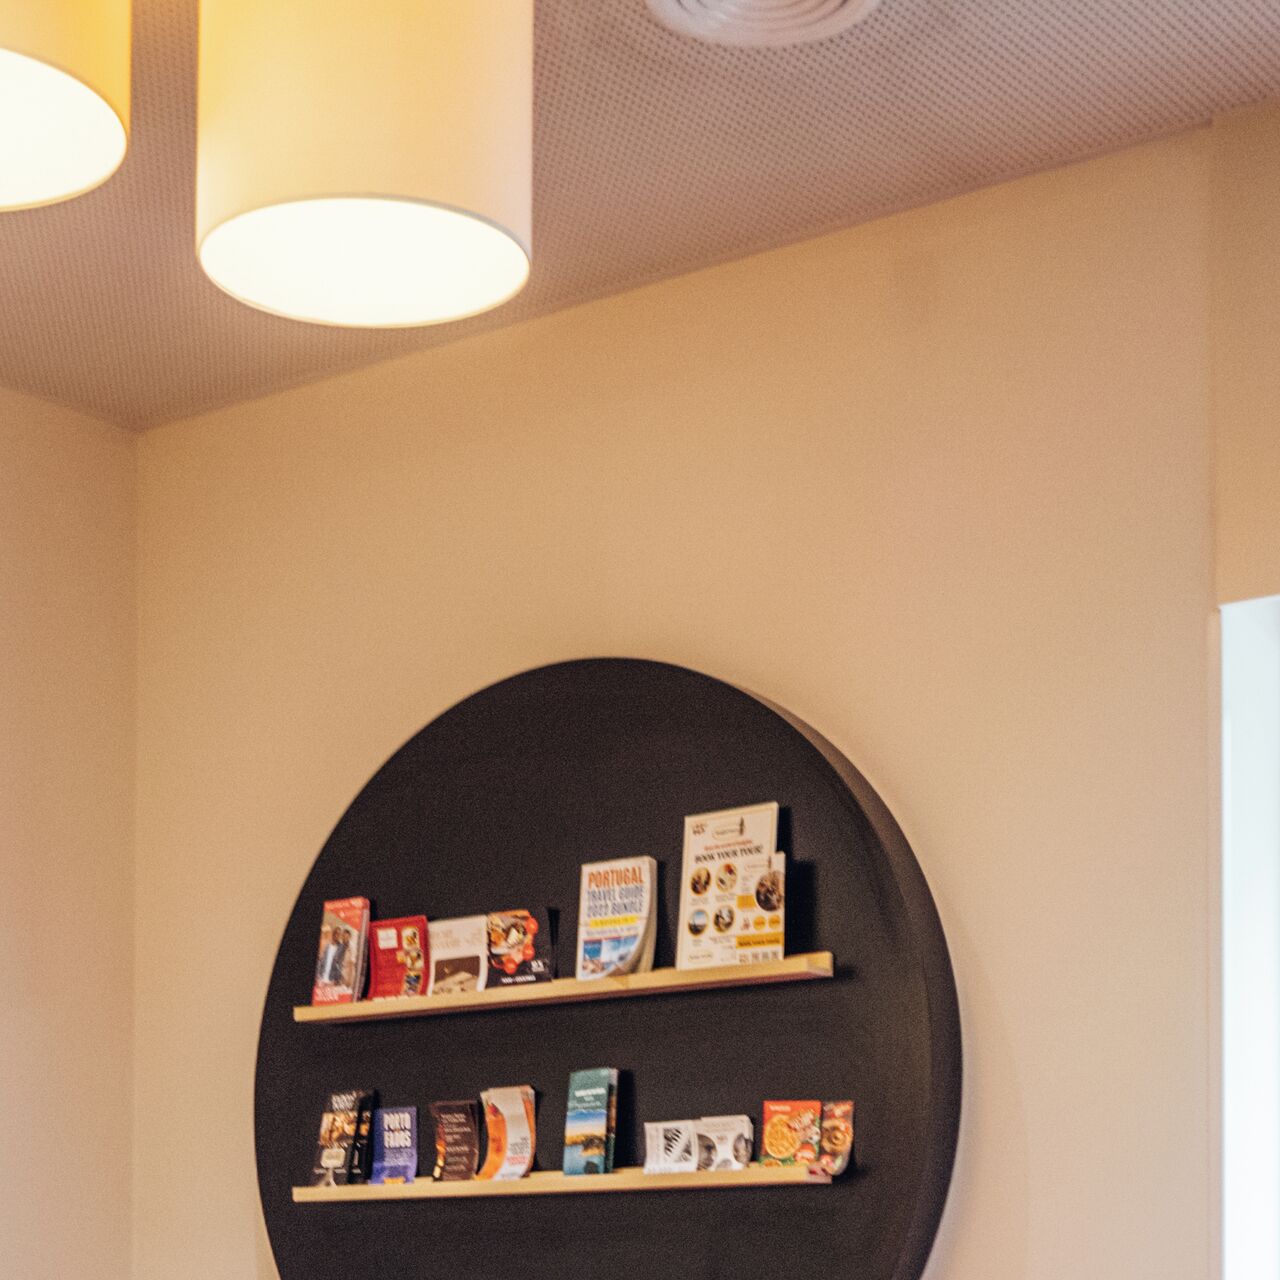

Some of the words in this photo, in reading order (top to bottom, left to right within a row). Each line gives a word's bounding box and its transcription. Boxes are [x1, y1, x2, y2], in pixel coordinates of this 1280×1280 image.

[587, 866, 643, 889] PORTUGAL
[587, 887, 617, 903] TRAVEL
[619, 885, 644, 900] GUIDE
